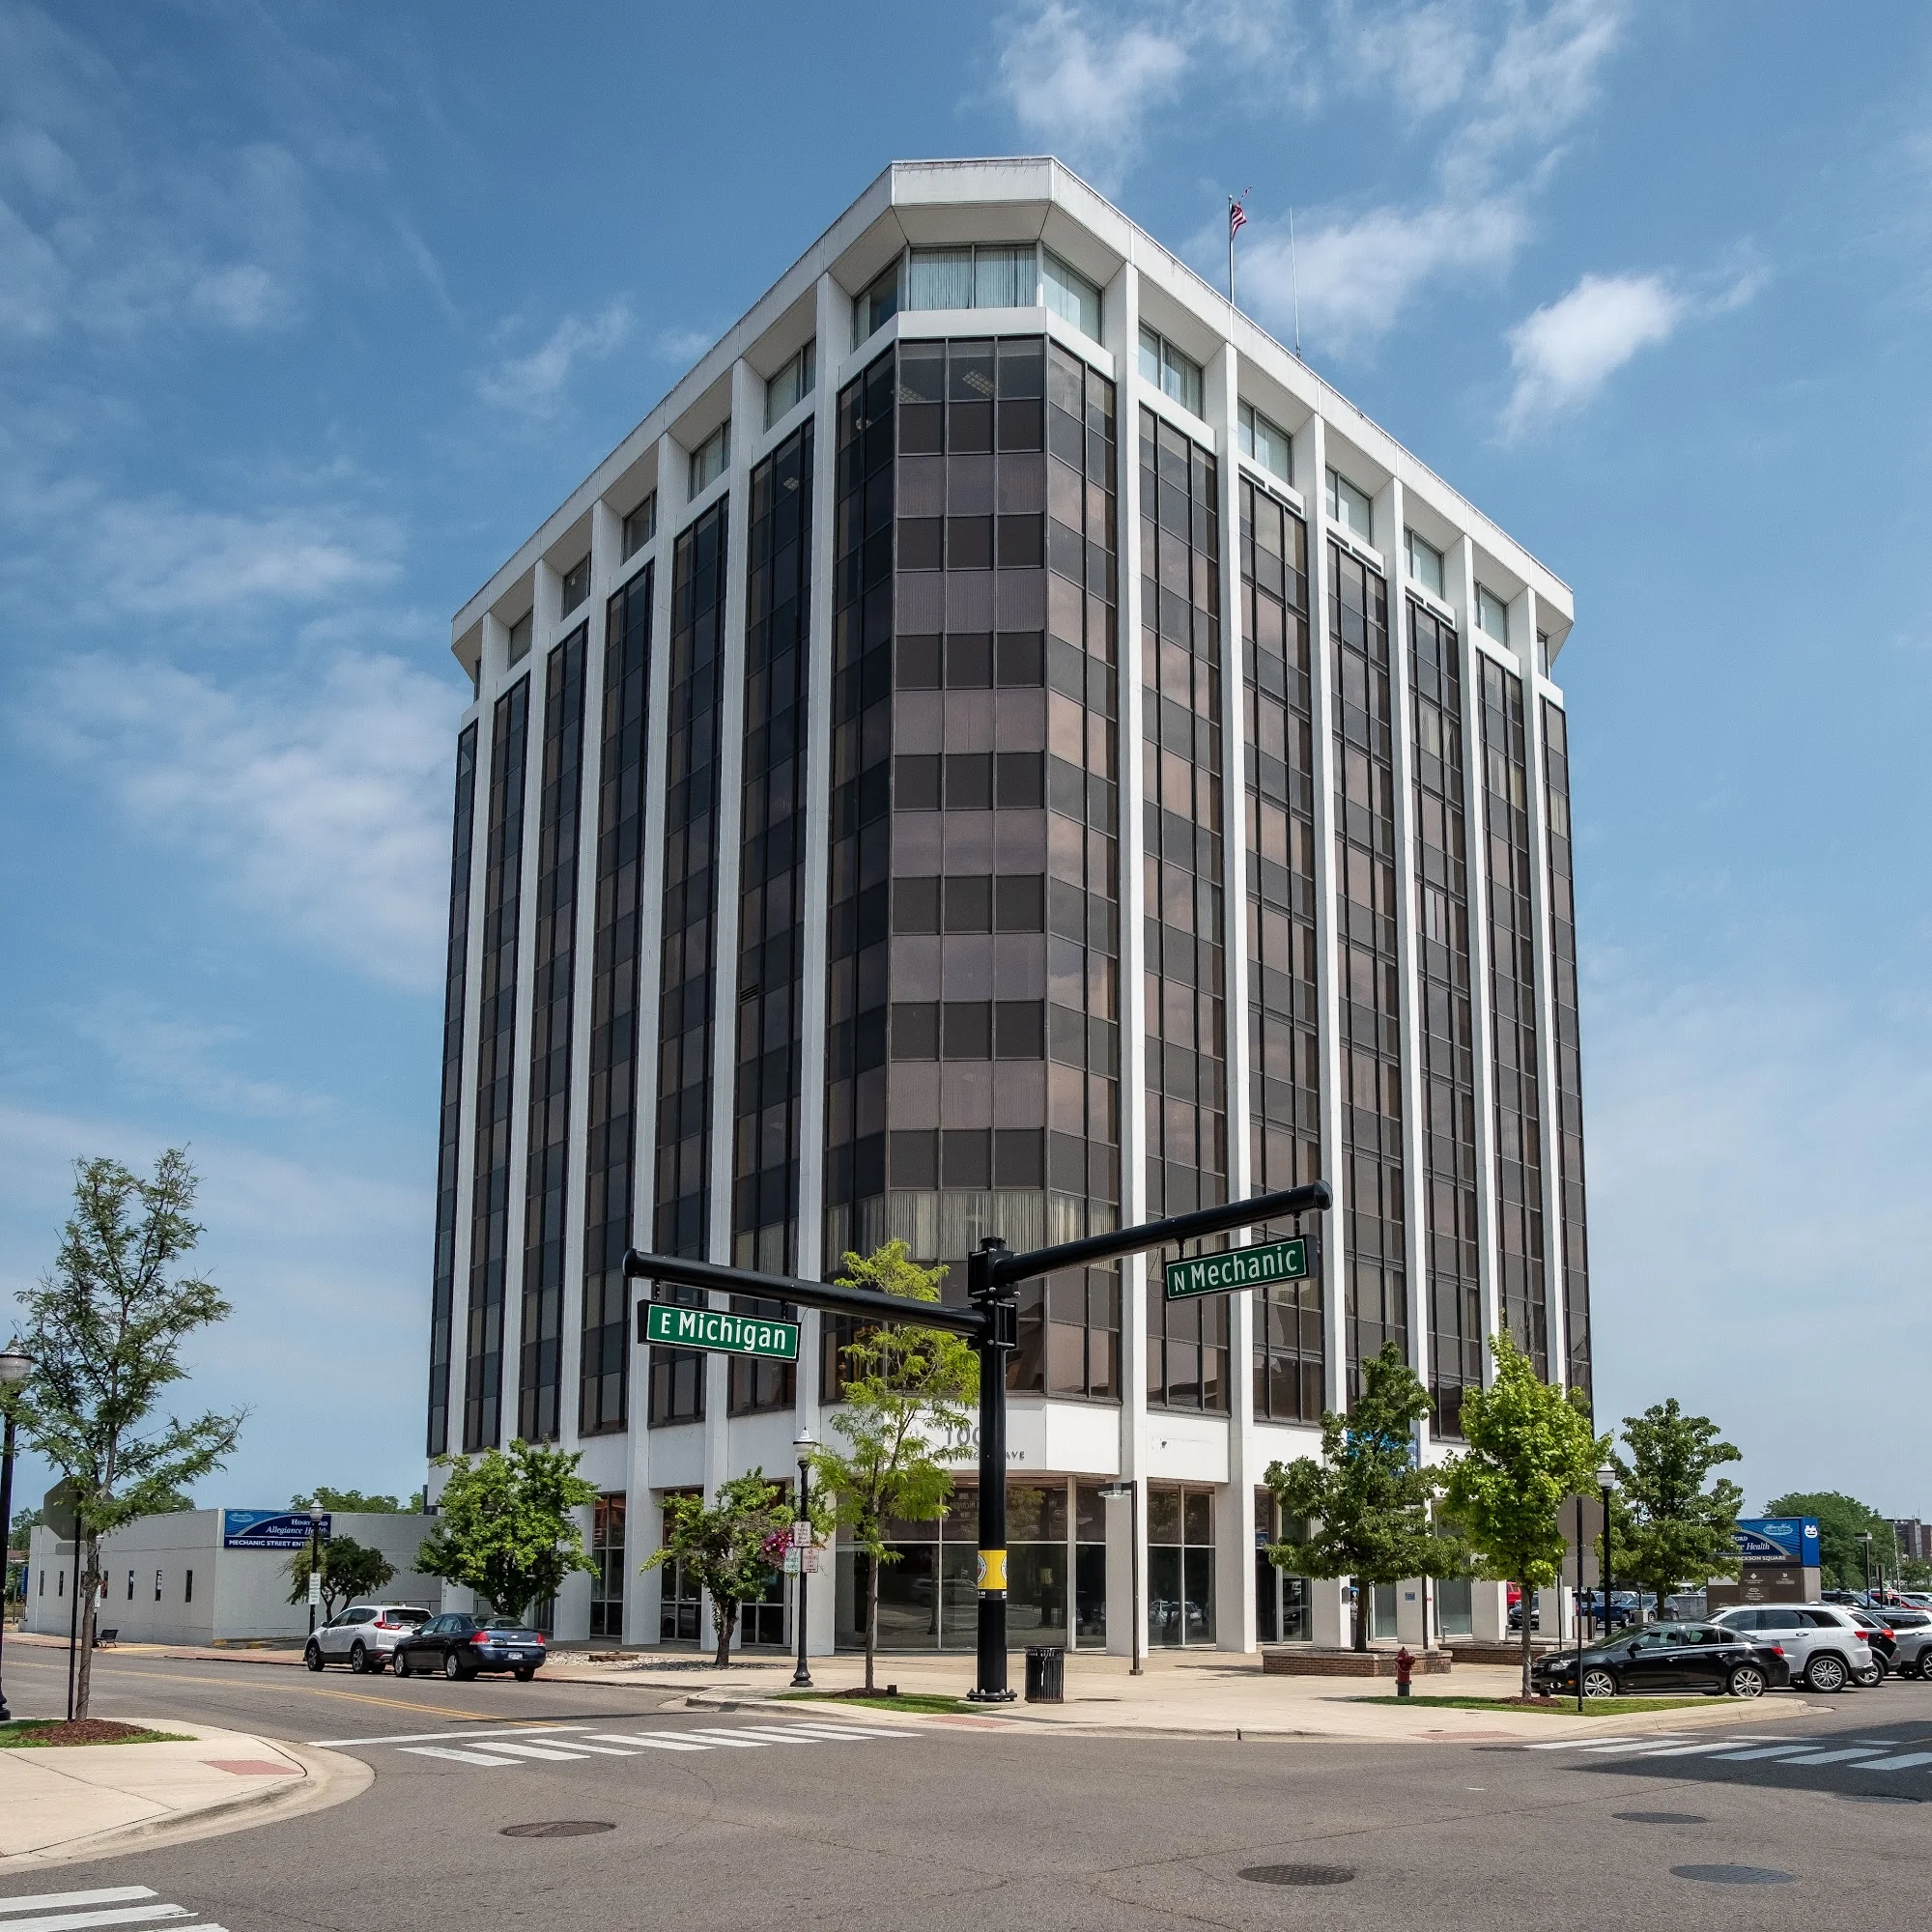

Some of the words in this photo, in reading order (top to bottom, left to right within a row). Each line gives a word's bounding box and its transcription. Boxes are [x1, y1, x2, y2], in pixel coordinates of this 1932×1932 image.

[1174, 1270, 1185, 1292] N
[1190, 1245, 1297, 1289] Mechanic
[661, 1312, 671, 1334] E
[678, 1311, 786, 1350] Michigan
[266, 1526, 303, 1535] Allegiance
[1746, 1542, 1770, 1550] Health
